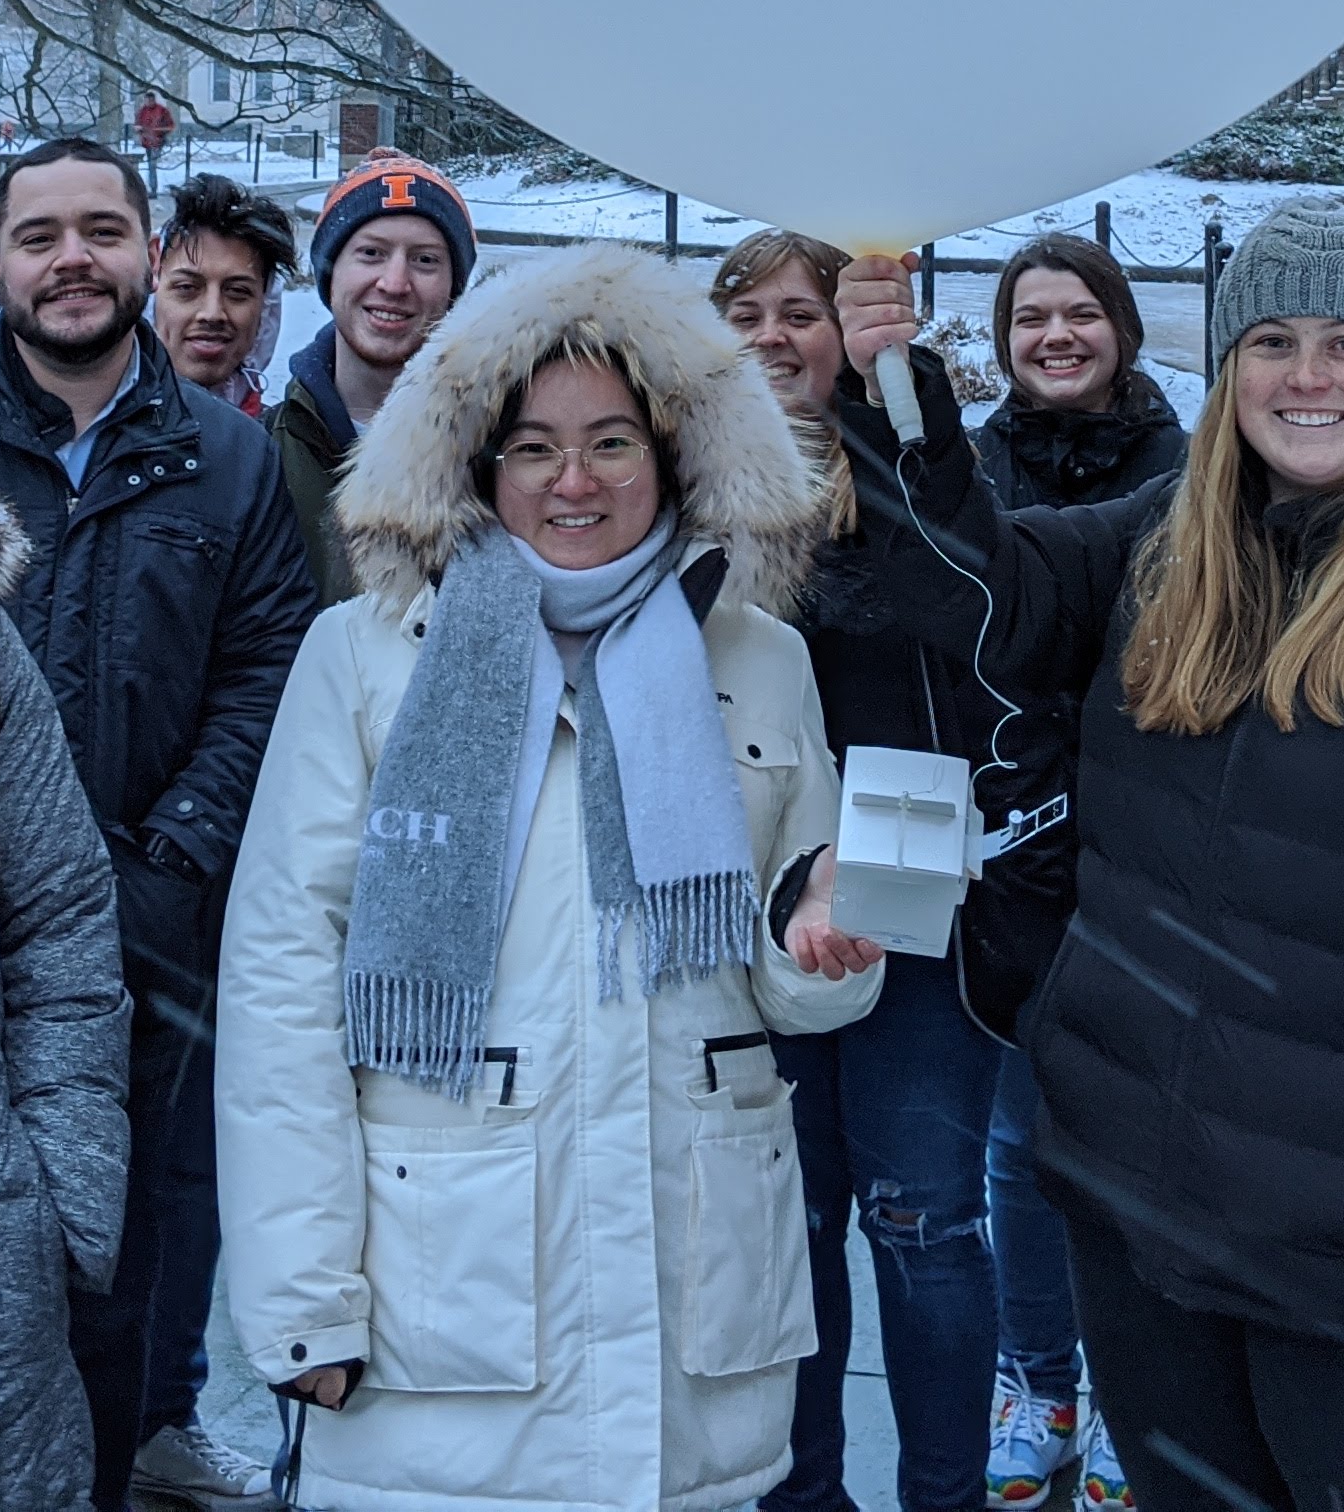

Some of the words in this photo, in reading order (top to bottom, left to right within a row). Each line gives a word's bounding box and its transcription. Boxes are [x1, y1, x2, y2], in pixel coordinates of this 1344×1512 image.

[382, 175, 416, 208] I
[716, 693, 734, 705] PA
[363, 807, 451, 844] CH
